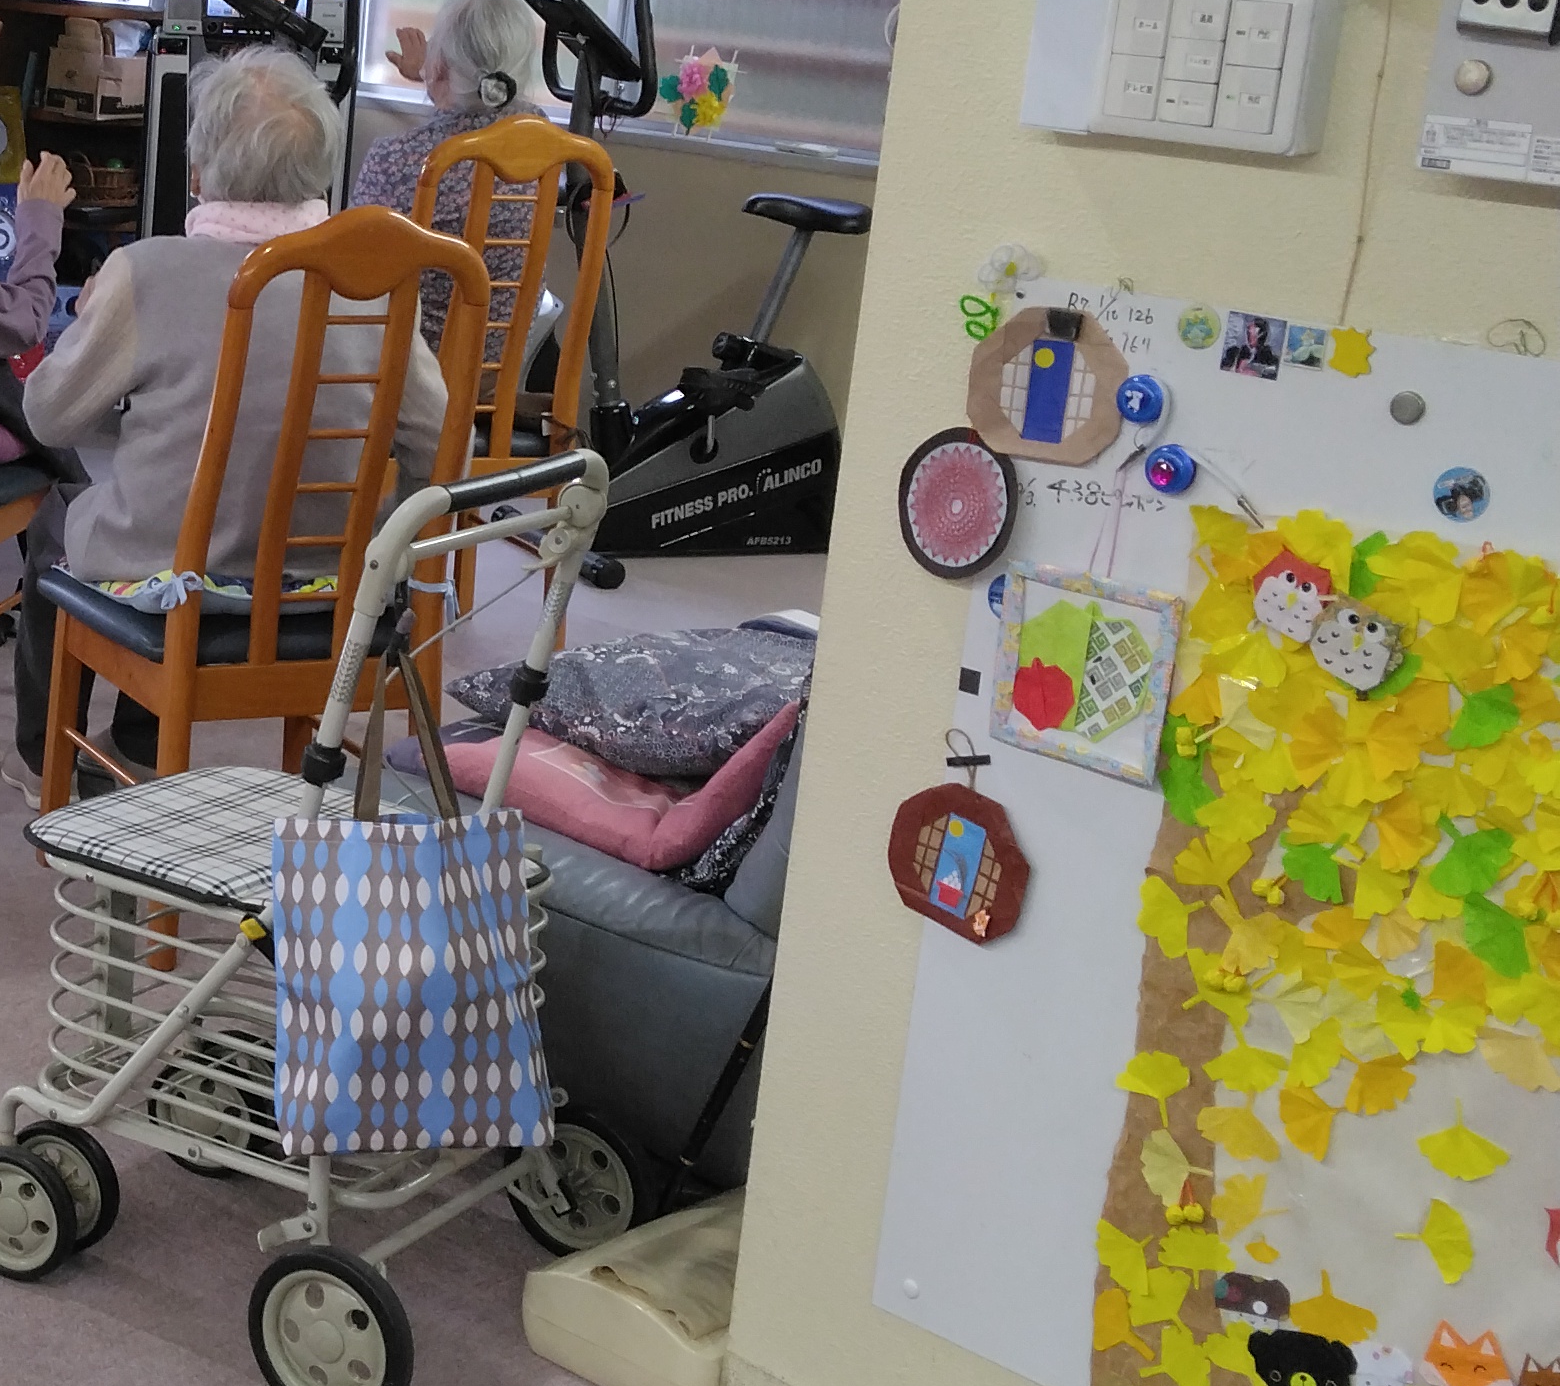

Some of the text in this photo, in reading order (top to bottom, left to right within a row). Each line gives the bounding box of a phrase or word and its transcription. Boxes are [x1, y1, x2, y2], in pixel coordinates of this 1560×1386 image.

[651, 458, 823, 529] FITNESS PRO. ALINCO
